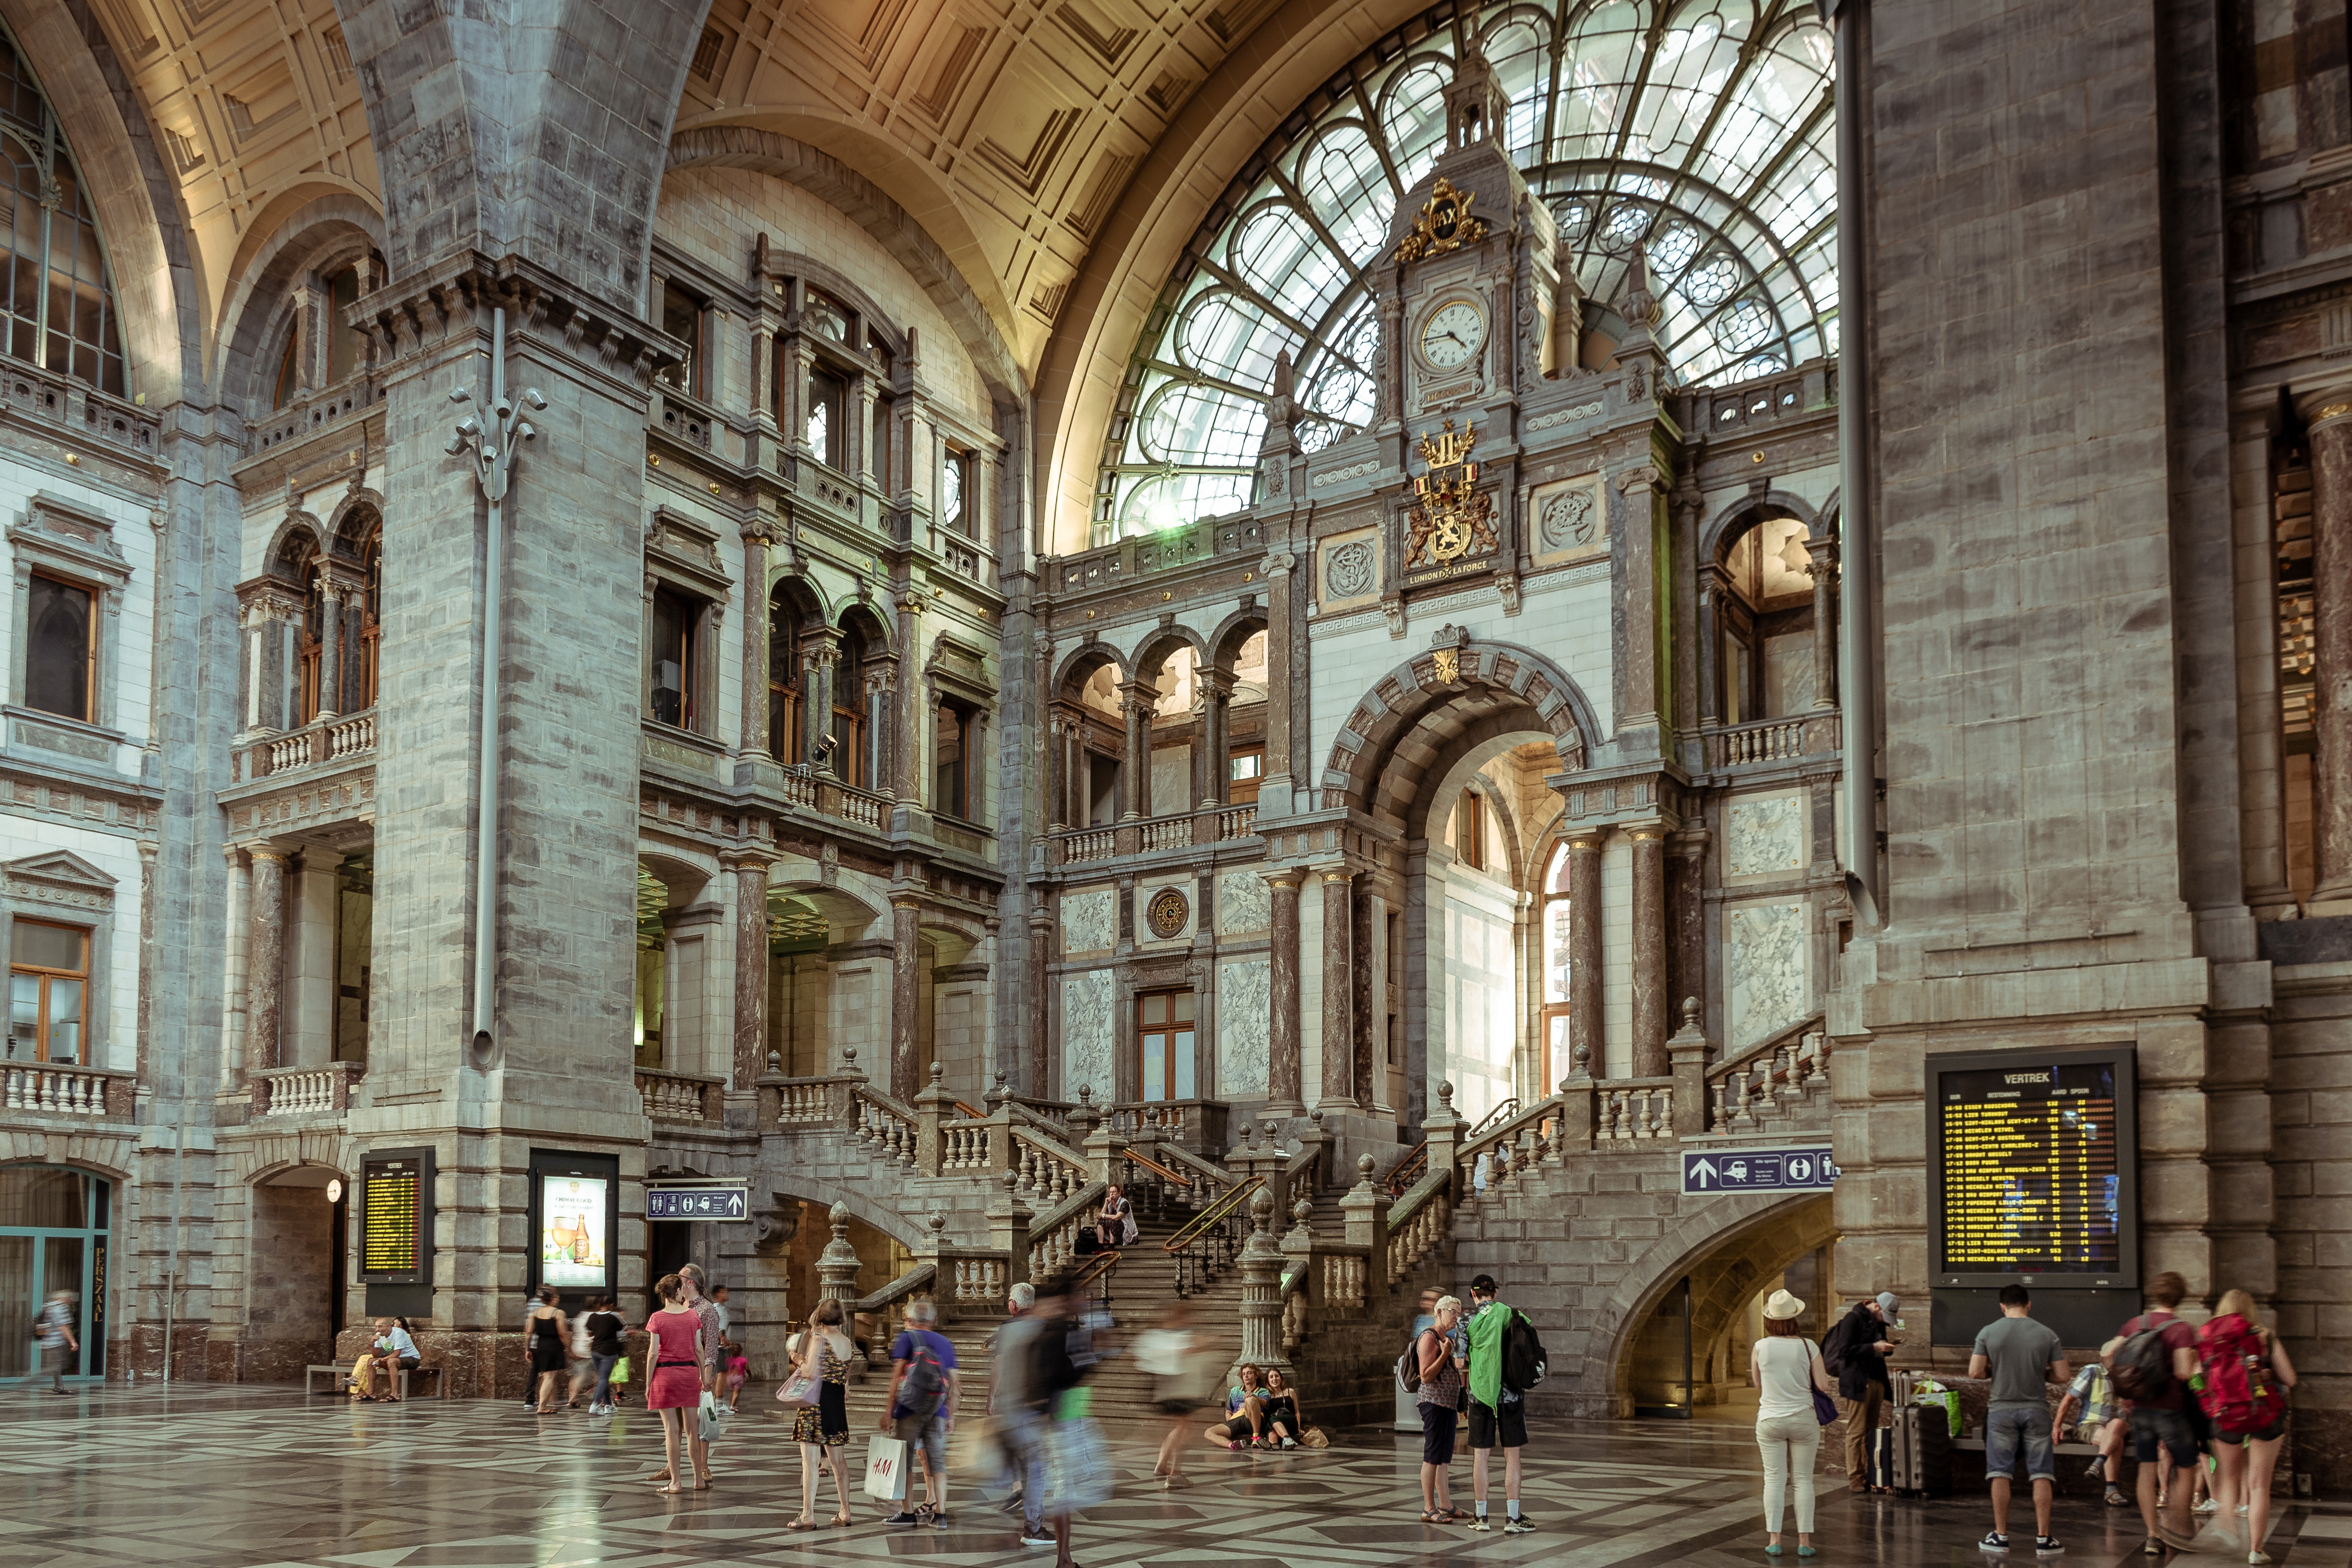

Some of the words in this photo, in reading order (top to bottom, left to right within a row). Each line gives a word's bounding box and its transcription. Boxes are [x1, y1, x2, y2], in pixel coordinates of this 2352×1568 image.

[1433, 208, 1457, 229] PAX
[1463, 561, 1487, 572] FORCE
[2004, 1073, 2050, 1084] VERTREK
[94, 1248, 105, 1322] PERSZAAL
